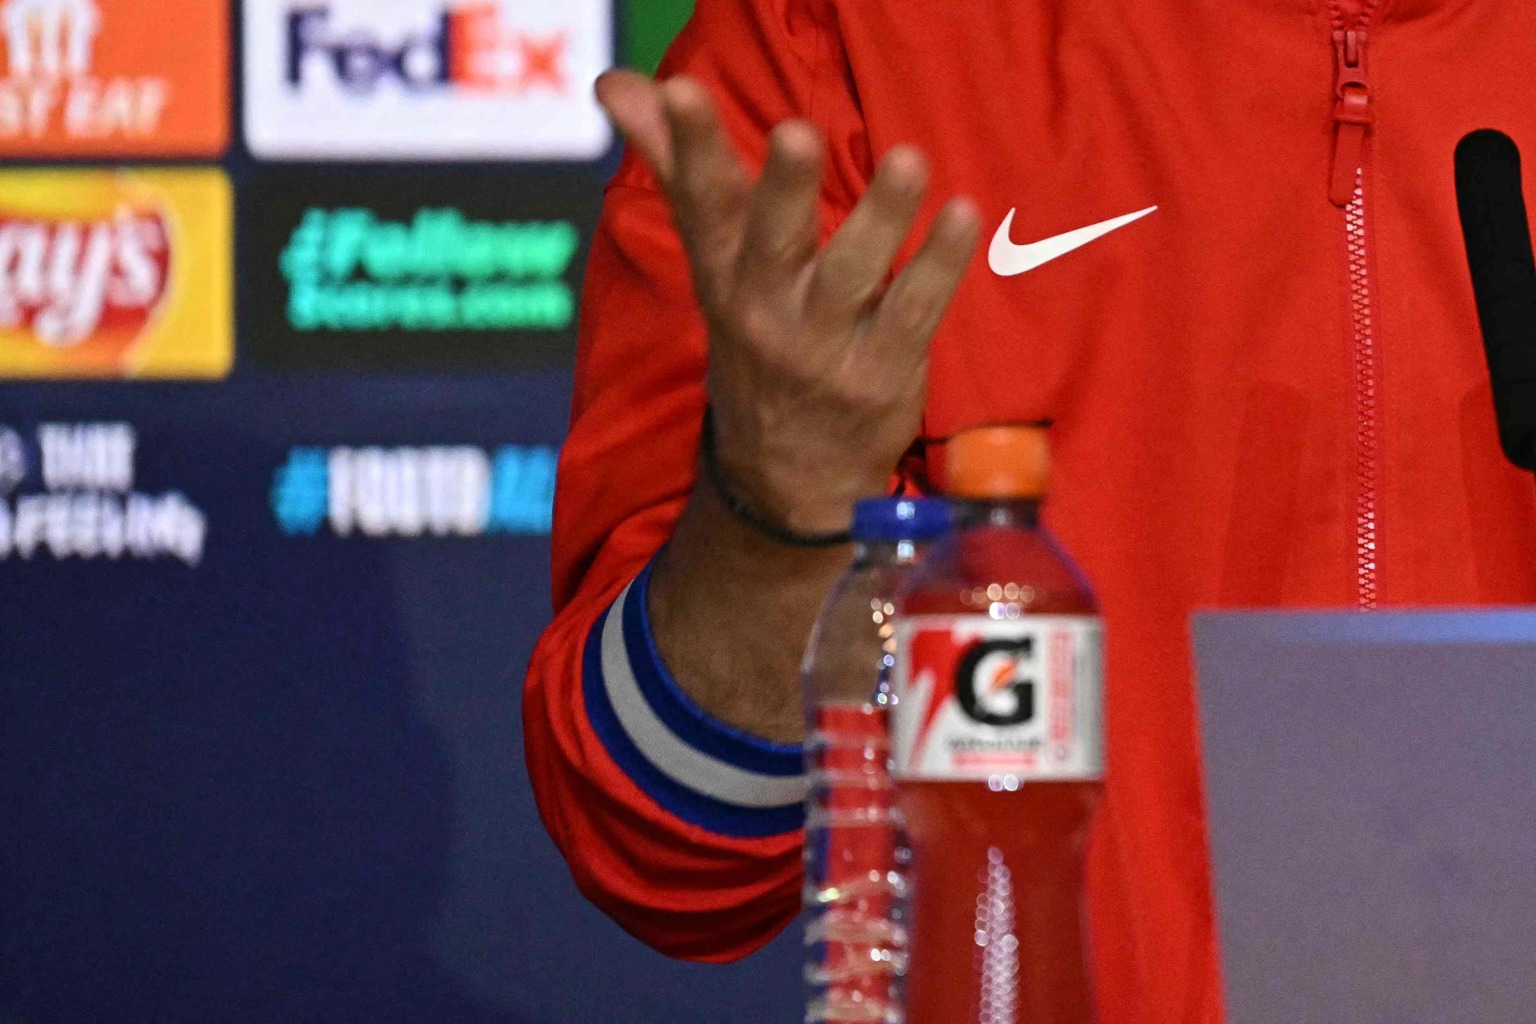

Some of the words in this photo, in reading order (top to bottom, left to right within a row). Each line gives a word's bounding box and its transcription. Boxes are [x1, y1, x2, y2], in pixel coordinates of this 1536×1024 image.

[285, 2, 568, 94] FedEx
[0, 202, 164, 347] ay's
[955, 637, 1035, 727] G
